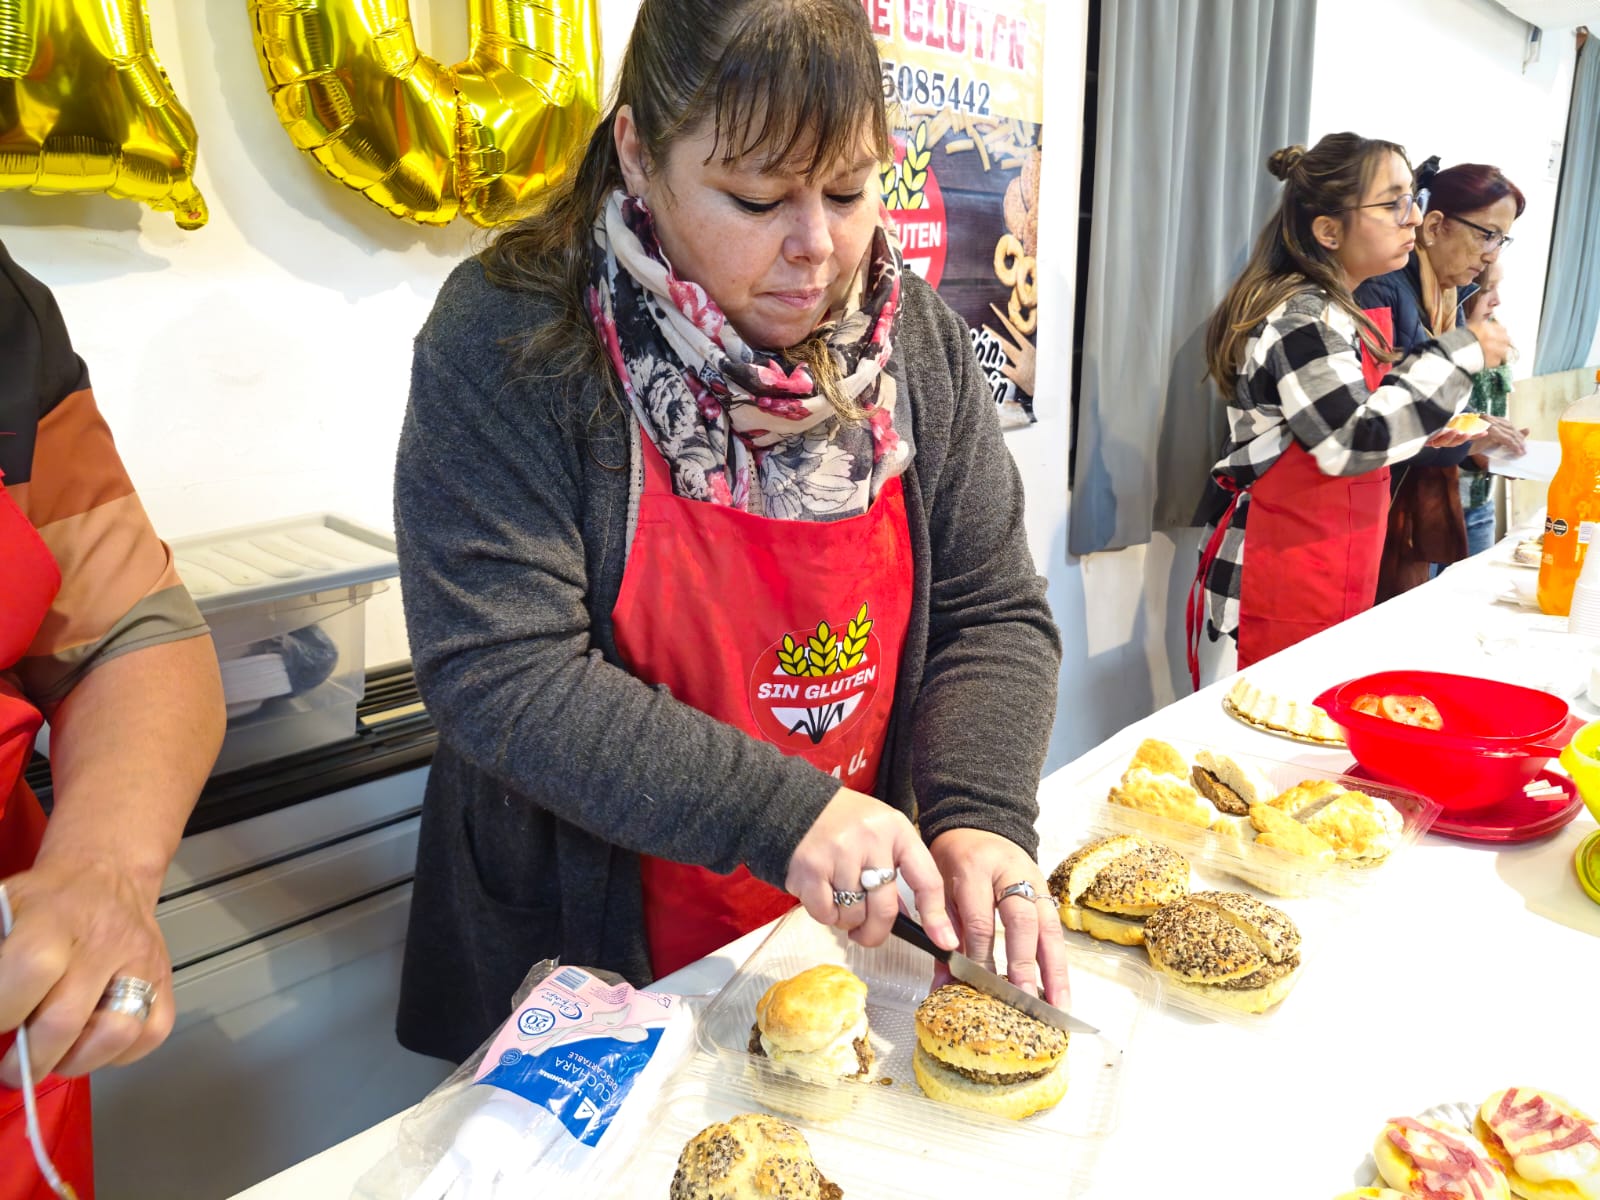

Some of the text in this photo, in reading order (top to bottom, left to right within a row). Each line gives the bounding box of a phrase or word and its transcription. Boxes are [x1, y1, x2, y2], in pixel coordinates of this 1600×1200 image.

[757, 664, 877, 700] SIN GLUTEN
[526, 1014, 549, 1028] 20
[555, 1056, 611, 1102] CUCHARA
[567, 1051, 619, 1092] DESCARTABLE
